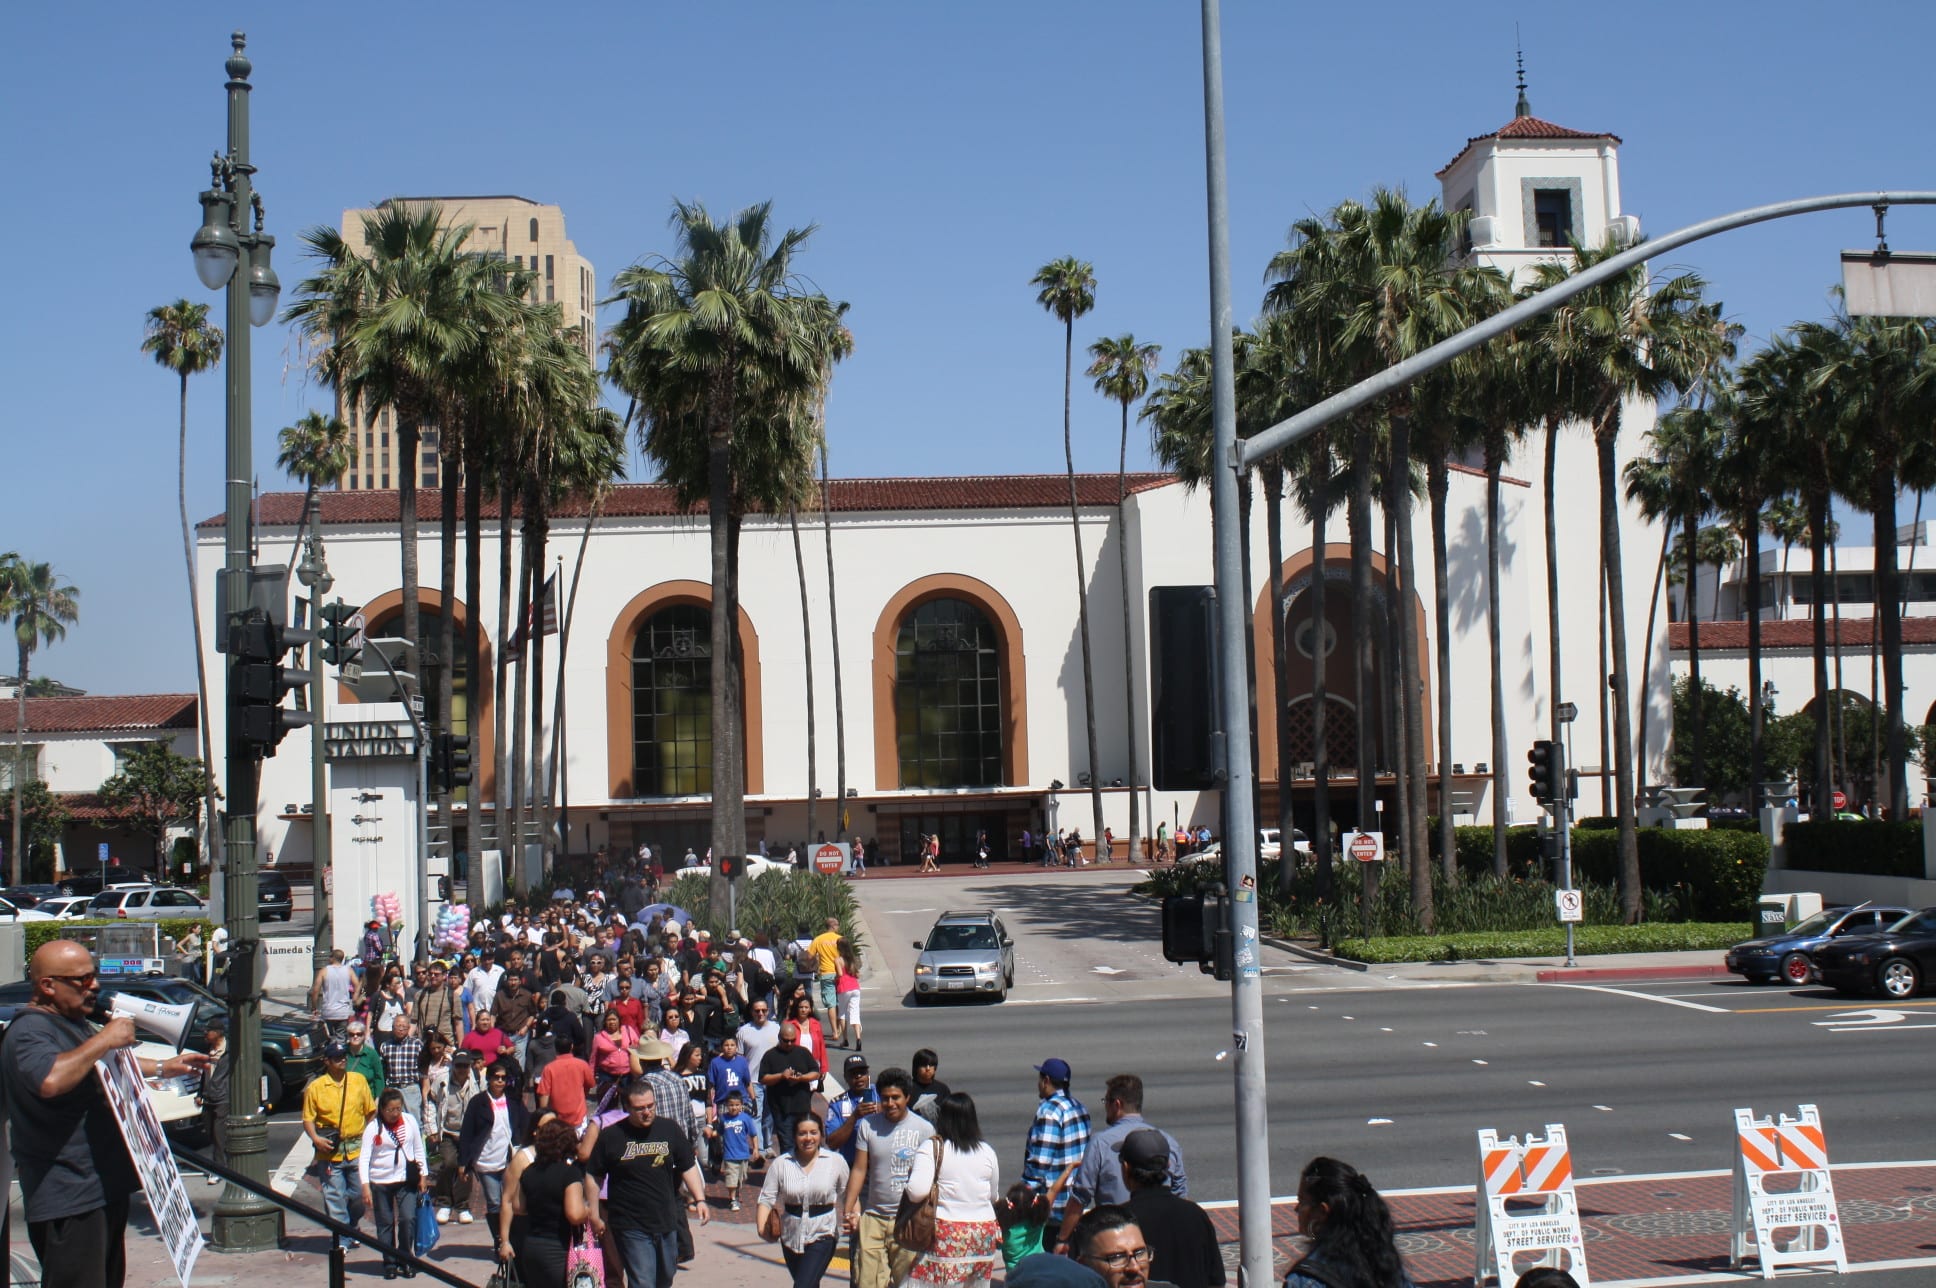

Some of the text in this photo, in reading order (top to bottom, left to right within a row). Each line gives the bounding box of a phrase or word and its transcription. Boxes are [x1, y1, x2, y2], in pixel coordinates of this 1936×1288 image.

[326, 723, 398, 739] UNION
[325, 740, 406, 757] STATION
[263, 946, 303, 954] Alameda
[726, 1068, 739, 1086] LA
[892, 1130, 920, 1150] AERO
[621, 1141, 670, 1160] LAKERS
[1766, 1212, 1826, 1224] STREET SERVICES
[1507, 1234, 1570, 1247] STREET SERVICES
